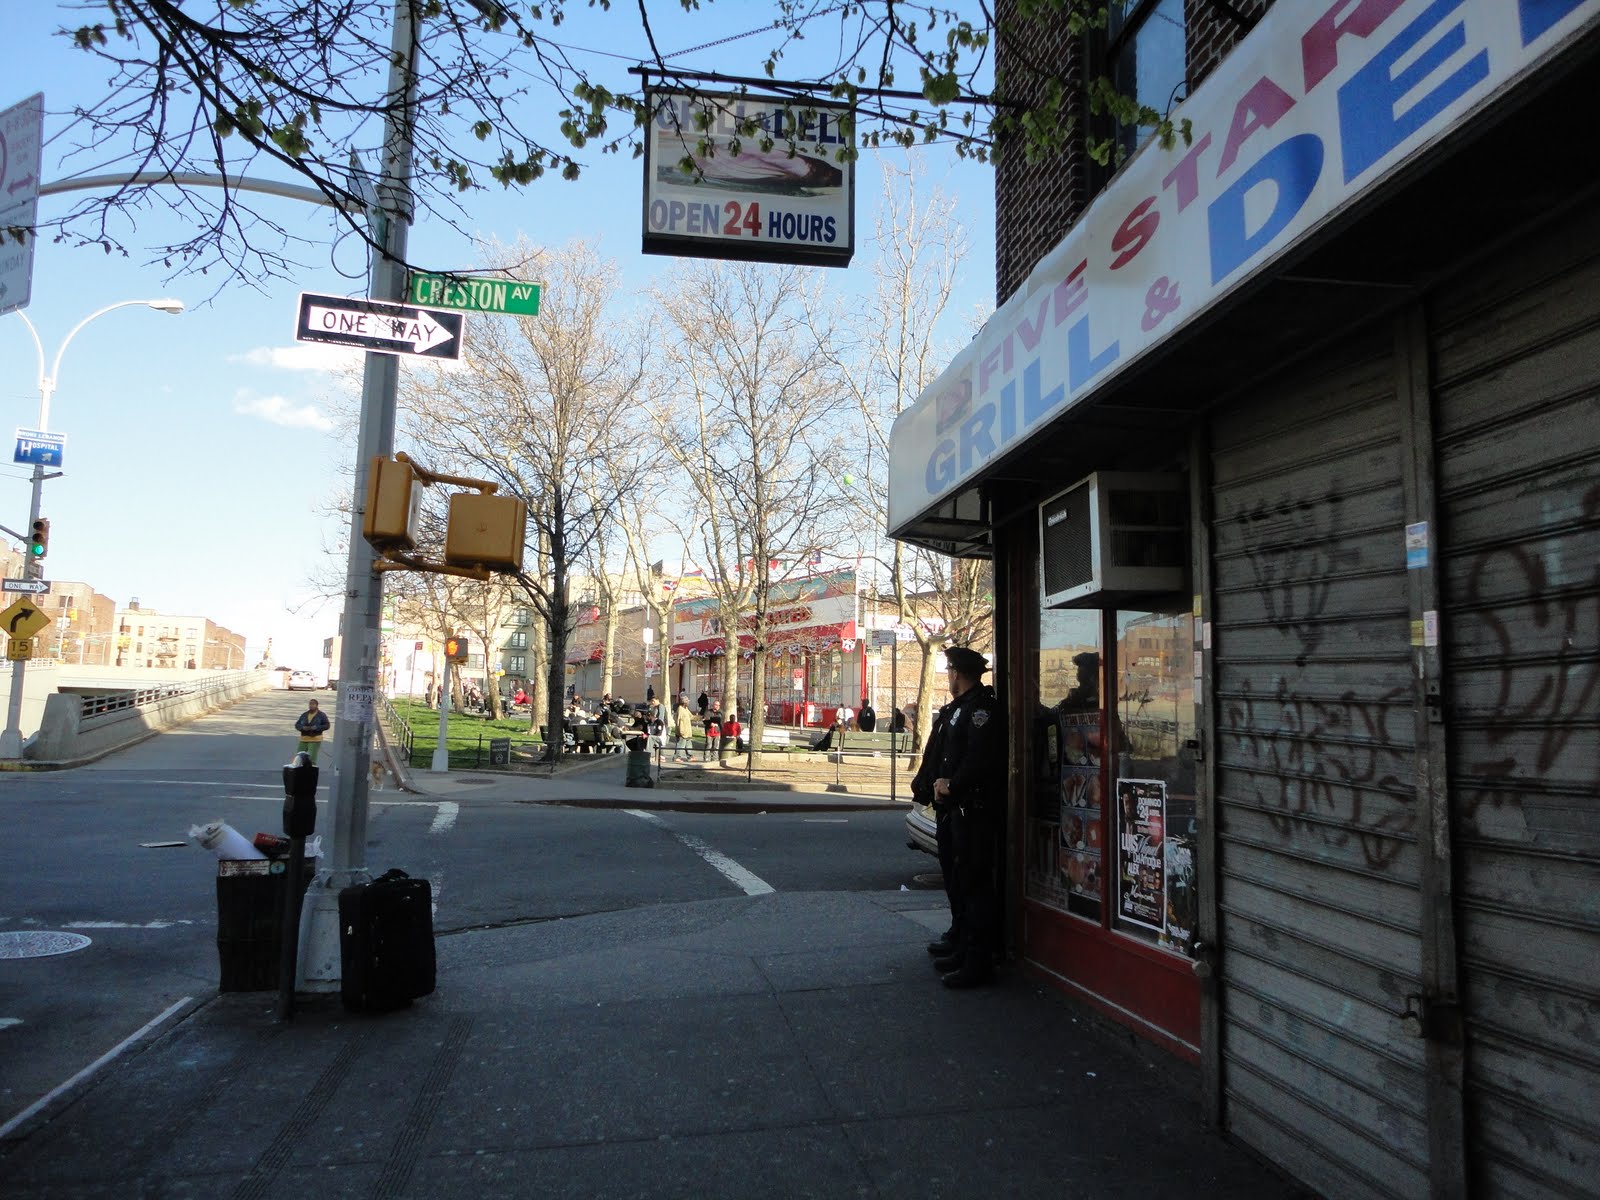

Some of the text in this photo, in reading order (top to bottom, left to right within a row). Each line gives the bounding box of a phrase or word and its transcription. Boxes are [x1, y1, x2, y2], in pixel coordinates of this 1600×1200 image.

[774, 108, 847, 145] DEL
[979, 0, 1402, 396] FIVE STAR
[649, 198, 837, 243] OPEN 24 HOURS
[0, 252, 25, 276] UNDAY
[415, 277, 533, 311] CRESTON AV
[323, 310, 437, 343] ONE WAY
[924, 312, 1120, 495] GRILL
[1140, 275, 1182, 333] &
[20, 440, 59, 457] HOSPITAL
[12, 641, 29, 652] 15
[1137, 796, 1162, 808] DOMINGO
[1139, 805, 1149, 820] 24
